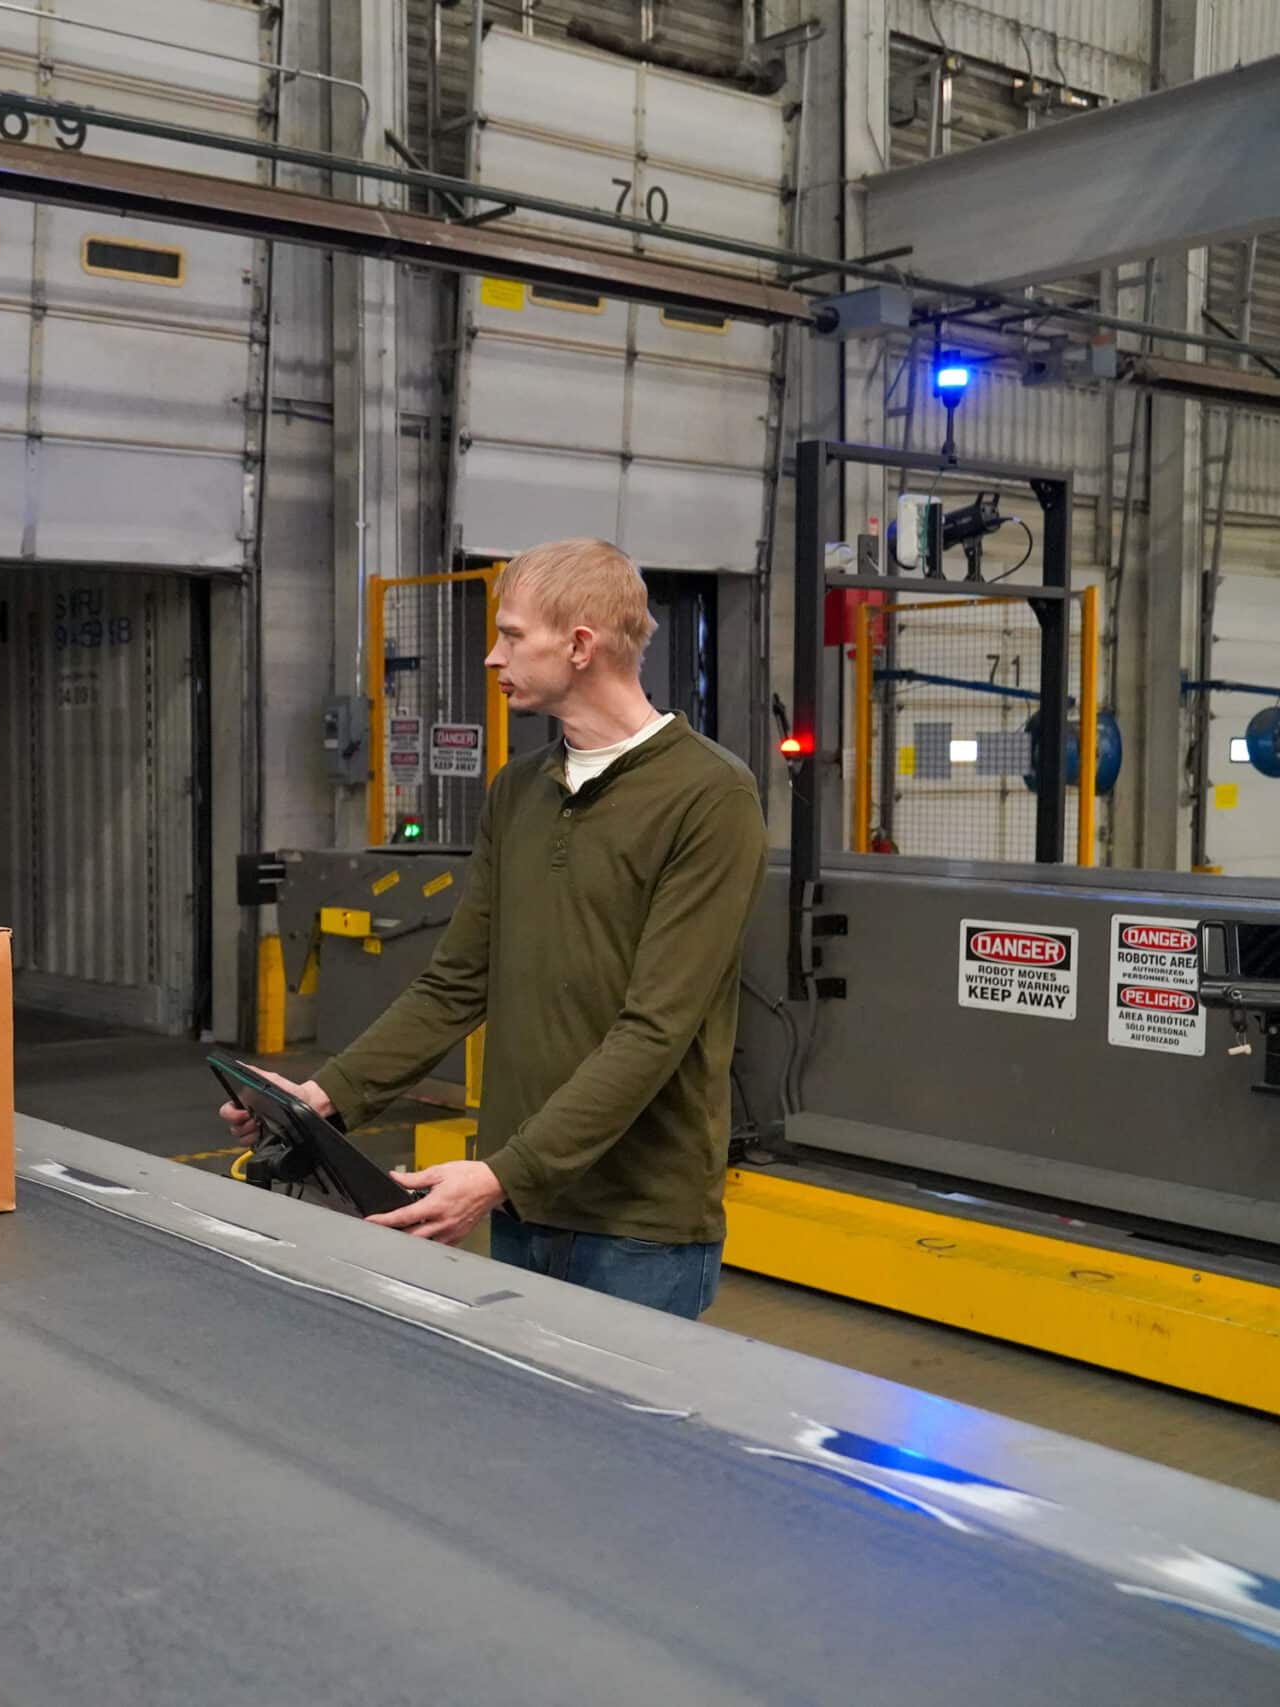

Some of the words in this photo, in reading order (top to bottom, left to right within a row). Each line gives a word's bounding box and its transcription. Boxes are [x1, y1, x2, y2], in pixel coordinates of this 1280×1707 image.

[612, 178, 668, 224] 70
[986, 654, 1020, 687] 71
[977, 935, 1059, 961] DANGER
[1127, 929, 1192, 948] DANGER
[1118, 951, 1167, 966] ROBOTIC
[978, 965, 1015, 977] ROBOT
[1018, 969, 1057, 982] MOVES
[1122, 972, 1170, 982] PERSONNEL
[1173, 977, 1194, 985] ONLY
[1132, 965, 1185, 977] AUTHORIZED
[965, 974, 1014, 988] WITHOUT
[1018, 980, 1070, 995] WARNING
[967, 985, 1012, 1002] KEEP
[1016, 991, 1066, 1009] AWAY
[1125, 989, 1191, 1009] PELIGRO
[1130, 1033, 1180, 1046] AUTORIZADO
[1147, 1024, 1187, 1037] PERSONAL
